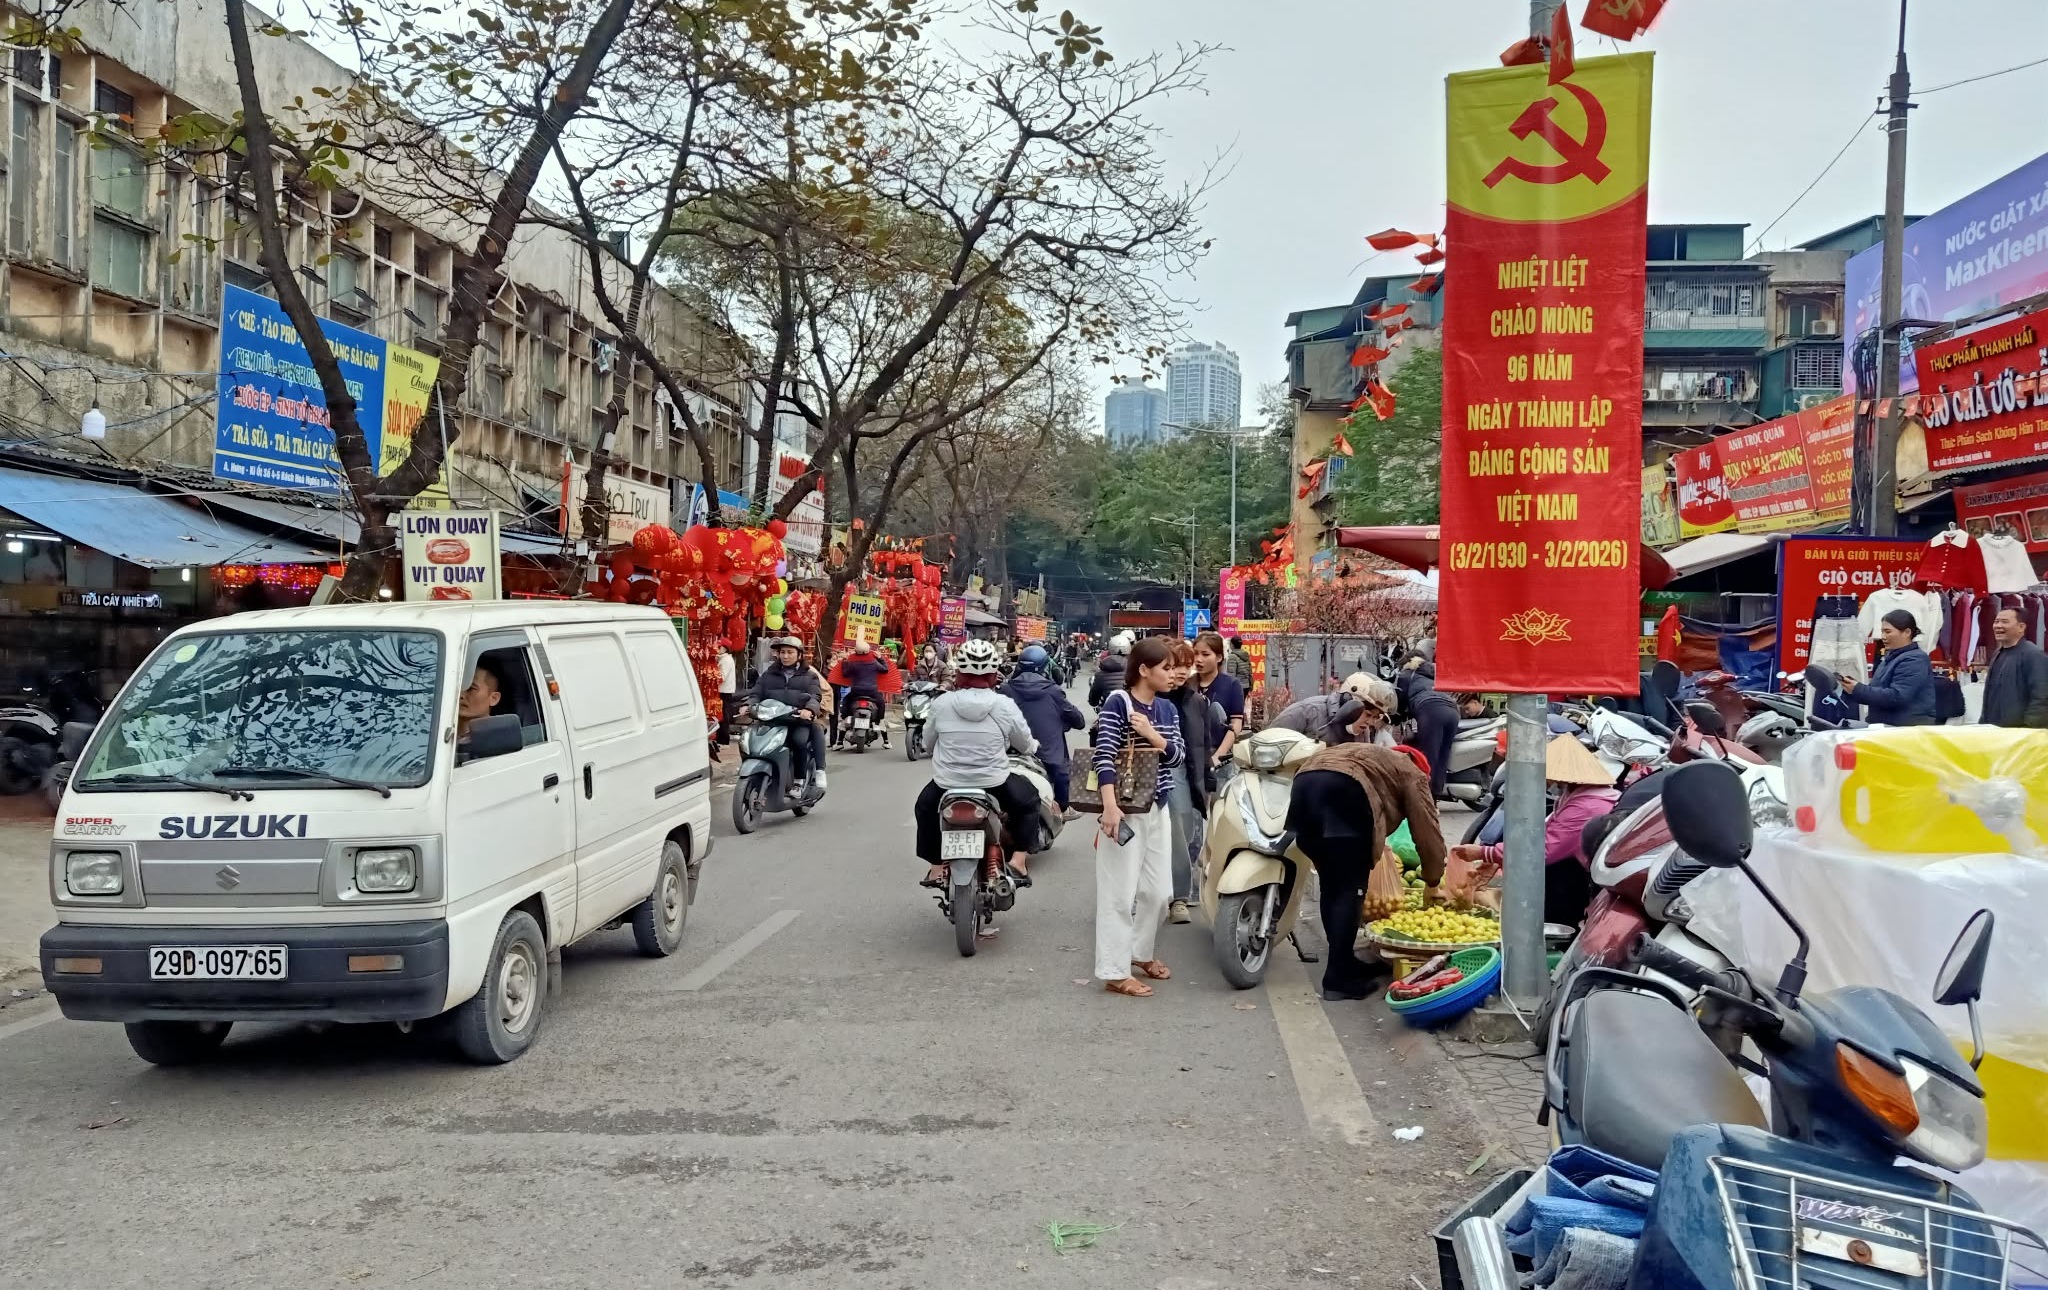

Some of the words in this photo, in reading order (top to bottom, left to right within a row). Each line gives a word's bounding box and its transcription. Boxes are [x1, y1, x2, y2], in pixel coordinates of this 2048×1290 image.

[1945, 220, 1987, 256] NƯỚC
[1989, 201, 2027, 234] GIẶT
[1945, 226, 2048, 292] MaxKleen
[1498, 254, 1548, 293] NHIỆT
[1552, 253, 1588, 293] LIỆT
[1490, 302, 1536, 338] CHÀO
[1541, 301, 1593, 335] MỪNG
[1929, 354, 1953, 373] THỰC
[1952, 338, 1979, 367] PHẨM
[1980, 335, 2013, 359] THANH
[2014, 325, 2034, 349] HẢI
[1507, 354, 1528, 383] 96
[1533, 348, 1573, 381] NĂM
[1467, 398, 1513, 431] NGÀY
[1518, 394, 1574, 428] THÀNH
[1579, 394, 1612, 433] LẬP
[1469, 440, 1514, 477] ĐẢNG
[1519, 441, 1567, 480] CỘNG
[1572, 438, 1610, 475] SẢN
[1497, 489, 1532, 527] VIỆT
[1537, 494, 1578, 521] NAM
[406, 515, 440, 537] LỢN
[446, 517, 488, 536] QUAY
[1450, 541, 1527, 572] (3/2/1930
[1544, 540, 1628, 570] 3/2/2026)
[1804, 548, 1828, 560] BÁN
[1830, 548, 1845, 561] VÀ
[1847, 548, 1869, 561] GIỚI
[1873, 549, 1903, 563] THIỆU
[1906, 549, 1922, 562] SẢ
[411, 566, 437, 586] VỊT
[443, 566, 486, 585] QUAY
[1818, 566, 1848, 585] GIÒ
[1851, 564, 1885, 586] CHẢ
[102, 593, 120, 607] CÂY
[850, 600, 867, 616] PHỞ
[869, 604, 881, 618] BÒ
[64, 824, 127, 836] CARRY
[65, 817, 113, 825] SUPER
[158, 814, 308, 839] SUZUKI
[1797, 1198, 1903, 1222] Wave
[1860, 1218, 1921, 1245] HONDA
